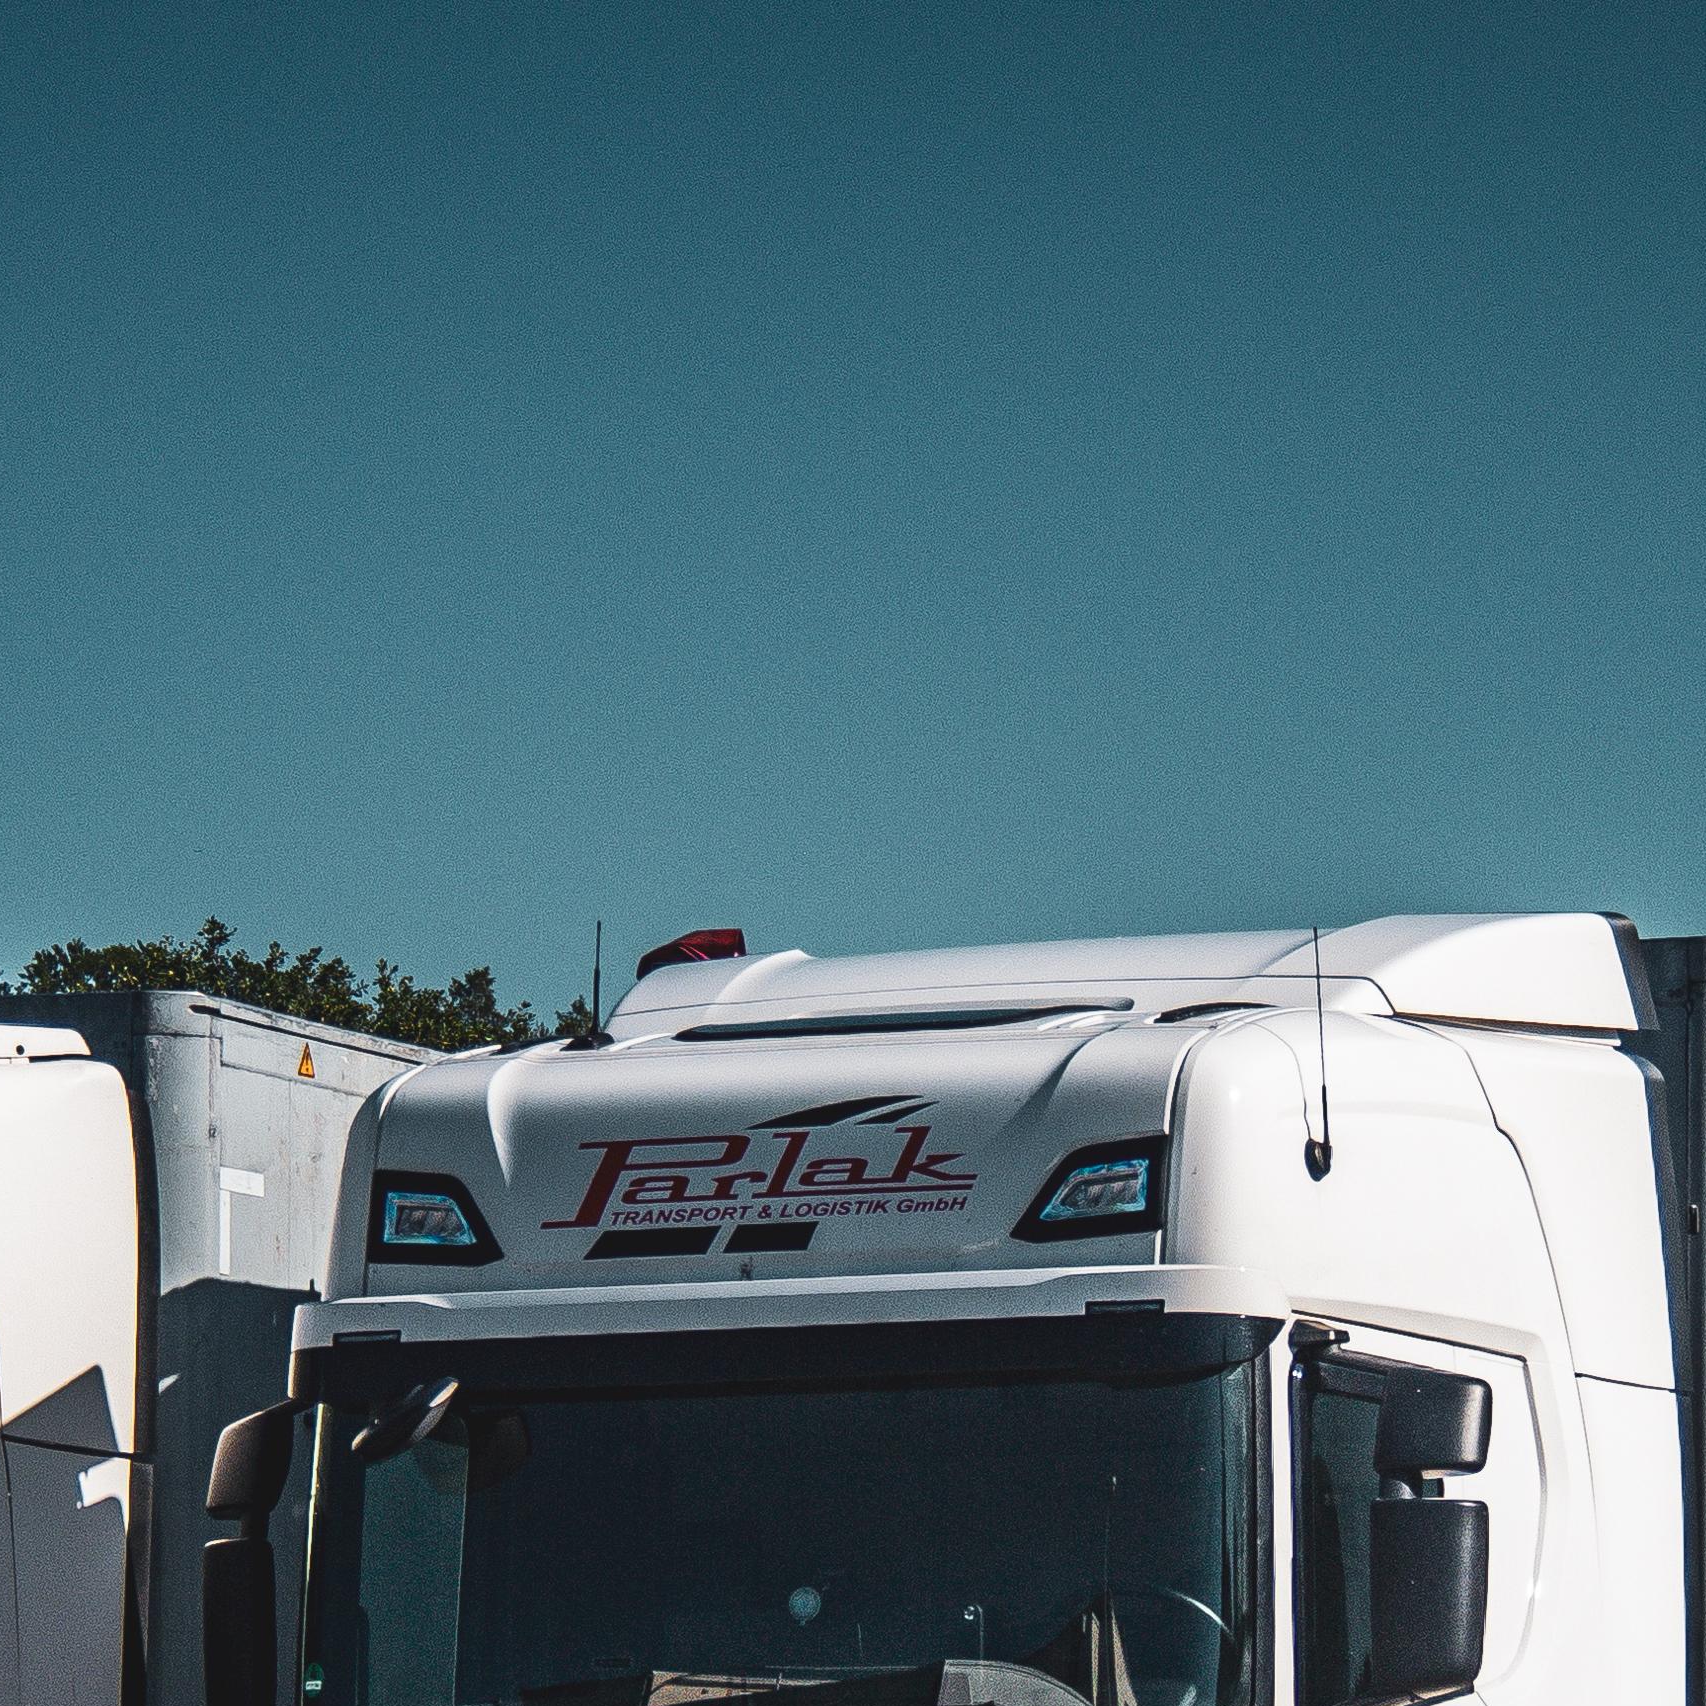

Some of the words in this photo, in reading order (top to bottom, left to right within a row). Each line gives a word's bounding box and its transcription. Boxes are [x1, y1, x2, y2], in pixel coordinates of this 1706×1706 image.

[540, 1125, 978, 1230] Parlak
[610, 1204, 753, 1226] TRANSPORT
[756, 1203, 774, 1219] &
[779, 1200, 890, 1219] LOGISTIK
[896, 1196, 969, 1213] GmbH
